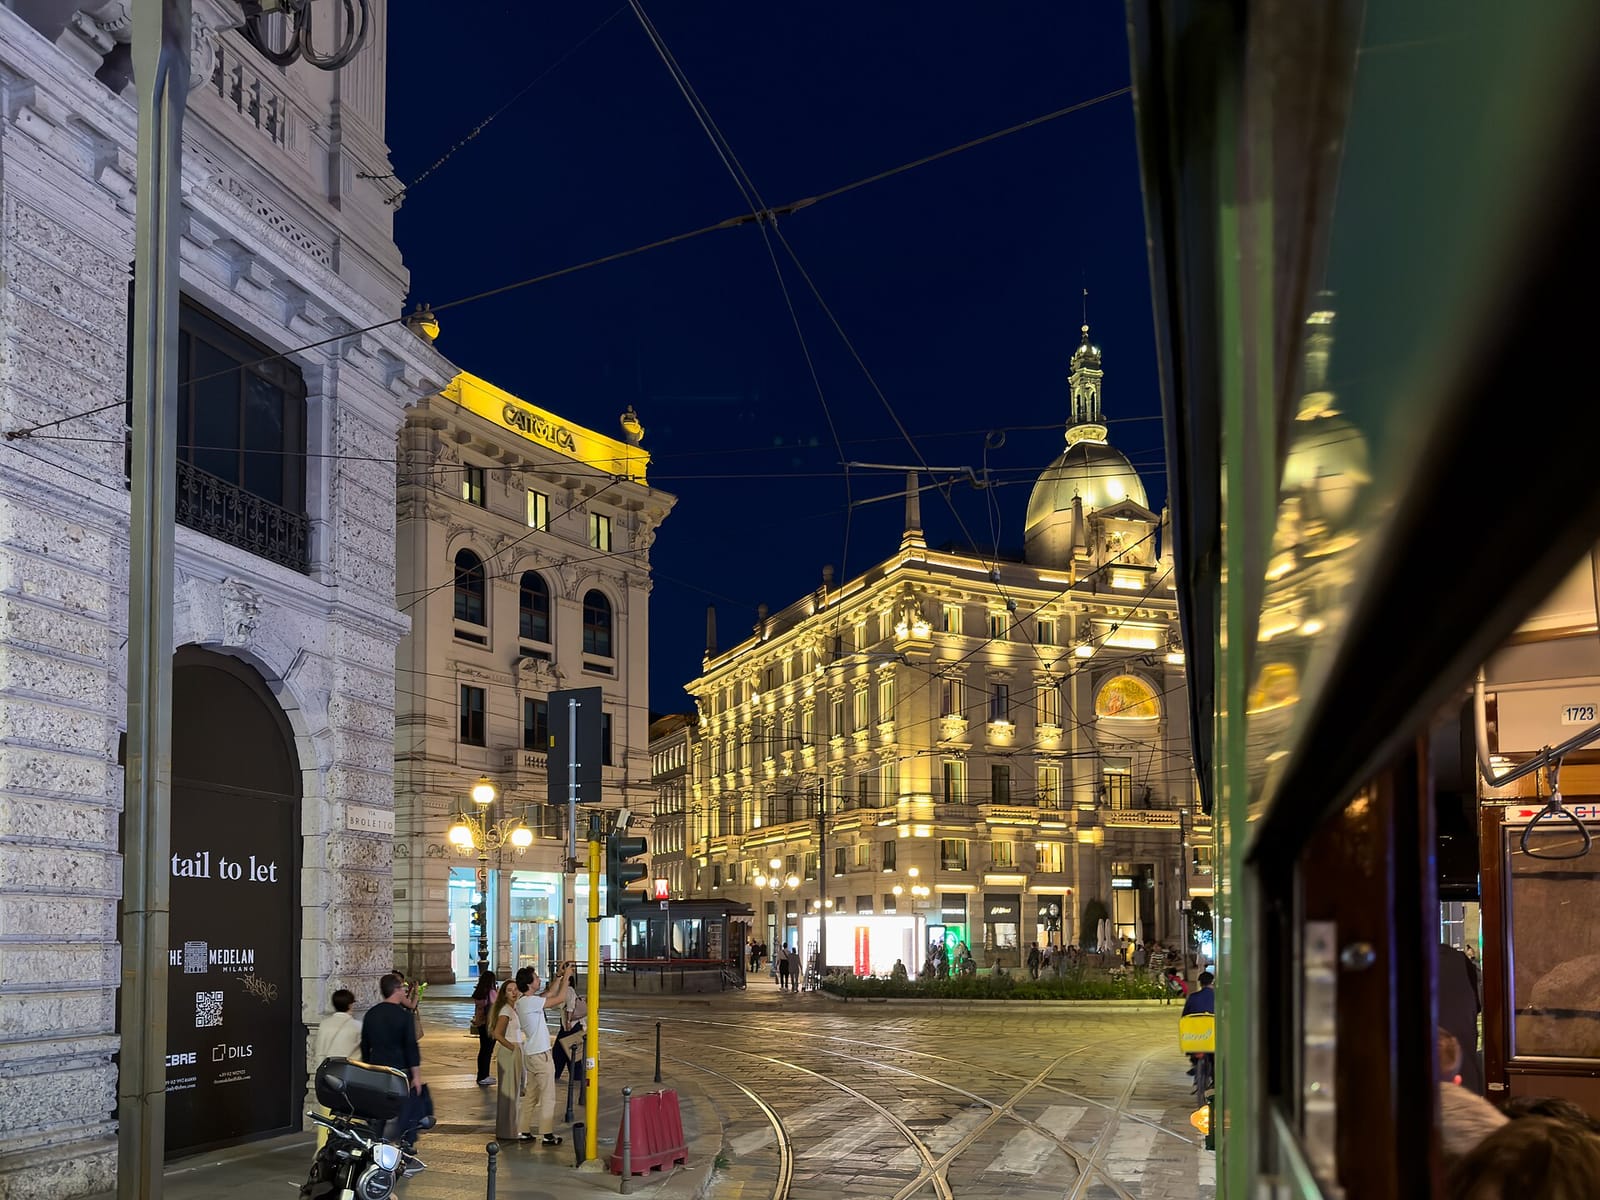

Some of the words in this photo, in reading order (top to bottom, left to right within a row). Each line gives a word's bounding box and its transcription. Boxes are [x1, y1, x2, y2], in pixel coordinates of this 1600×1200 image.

[1566, 707, 1594, 720] 1723
[350, 816, 393, 829] BROLETTO
[219, 856, 242, 880] to
[249, 855, 278, 882] let
[656, 879, 668, 896] M
[168, 949, 183, 966] HE
[209, 949, 254, 965] MEDELAN
[228, 1044, 253, 1059] DILS
